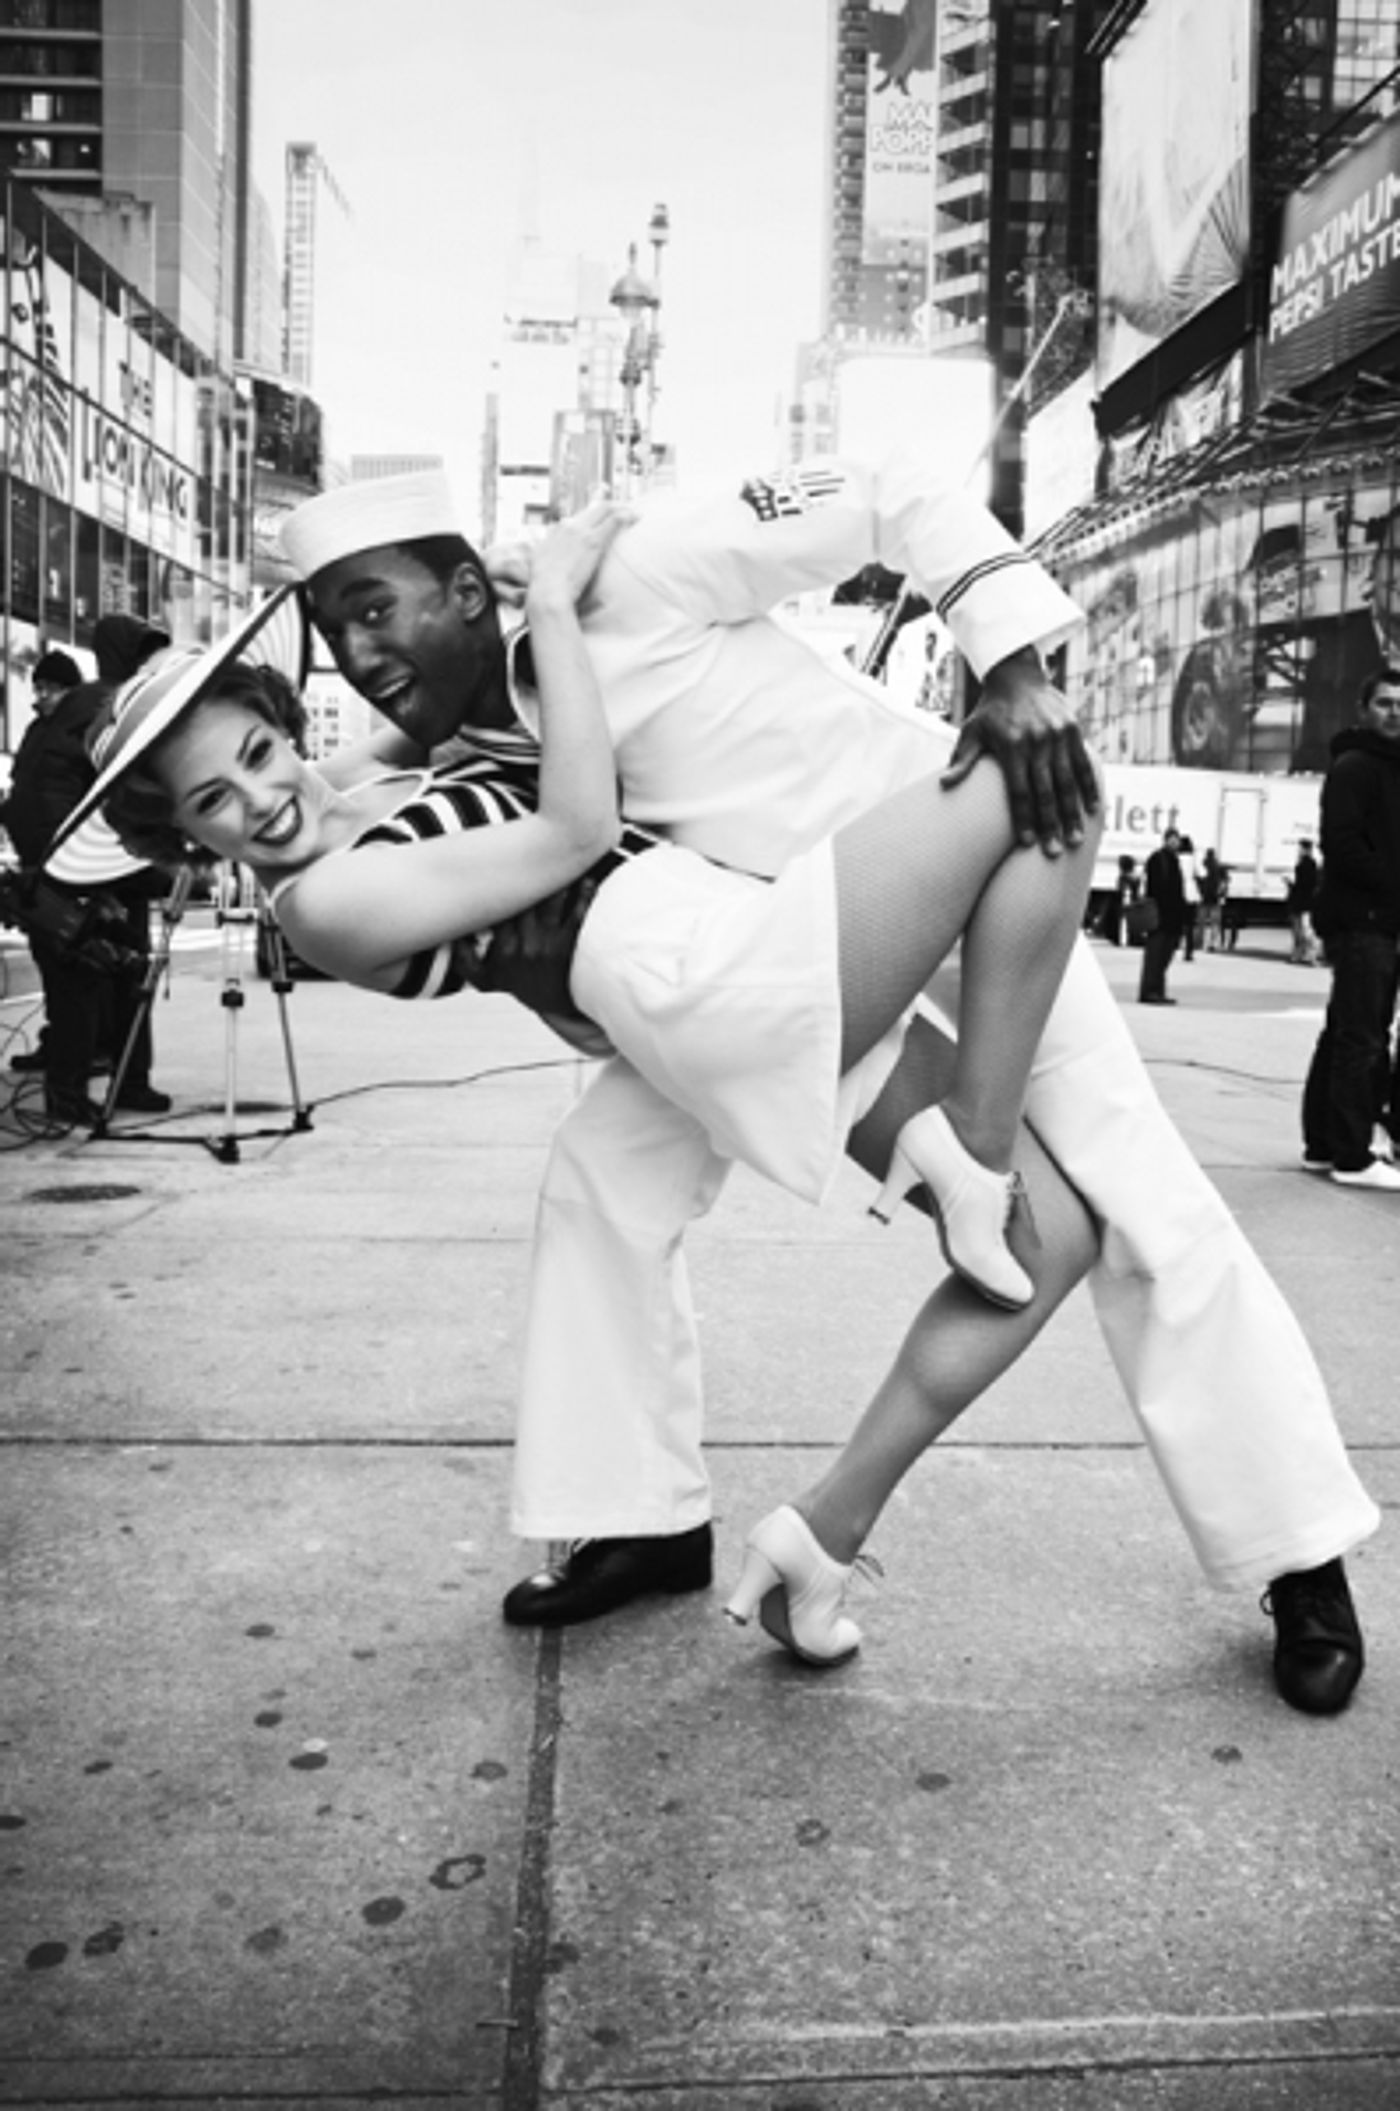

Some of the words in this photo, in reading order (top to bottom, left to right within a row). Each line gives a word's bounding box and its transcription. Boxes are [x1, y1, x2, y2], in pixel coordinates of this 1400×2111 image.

[1269, 276, 1324, 345] PEPSI
[118, 360, 152, 418] THE
[82, 387, 134, 488] LION
[1100, 794, 1180, 835] lett
